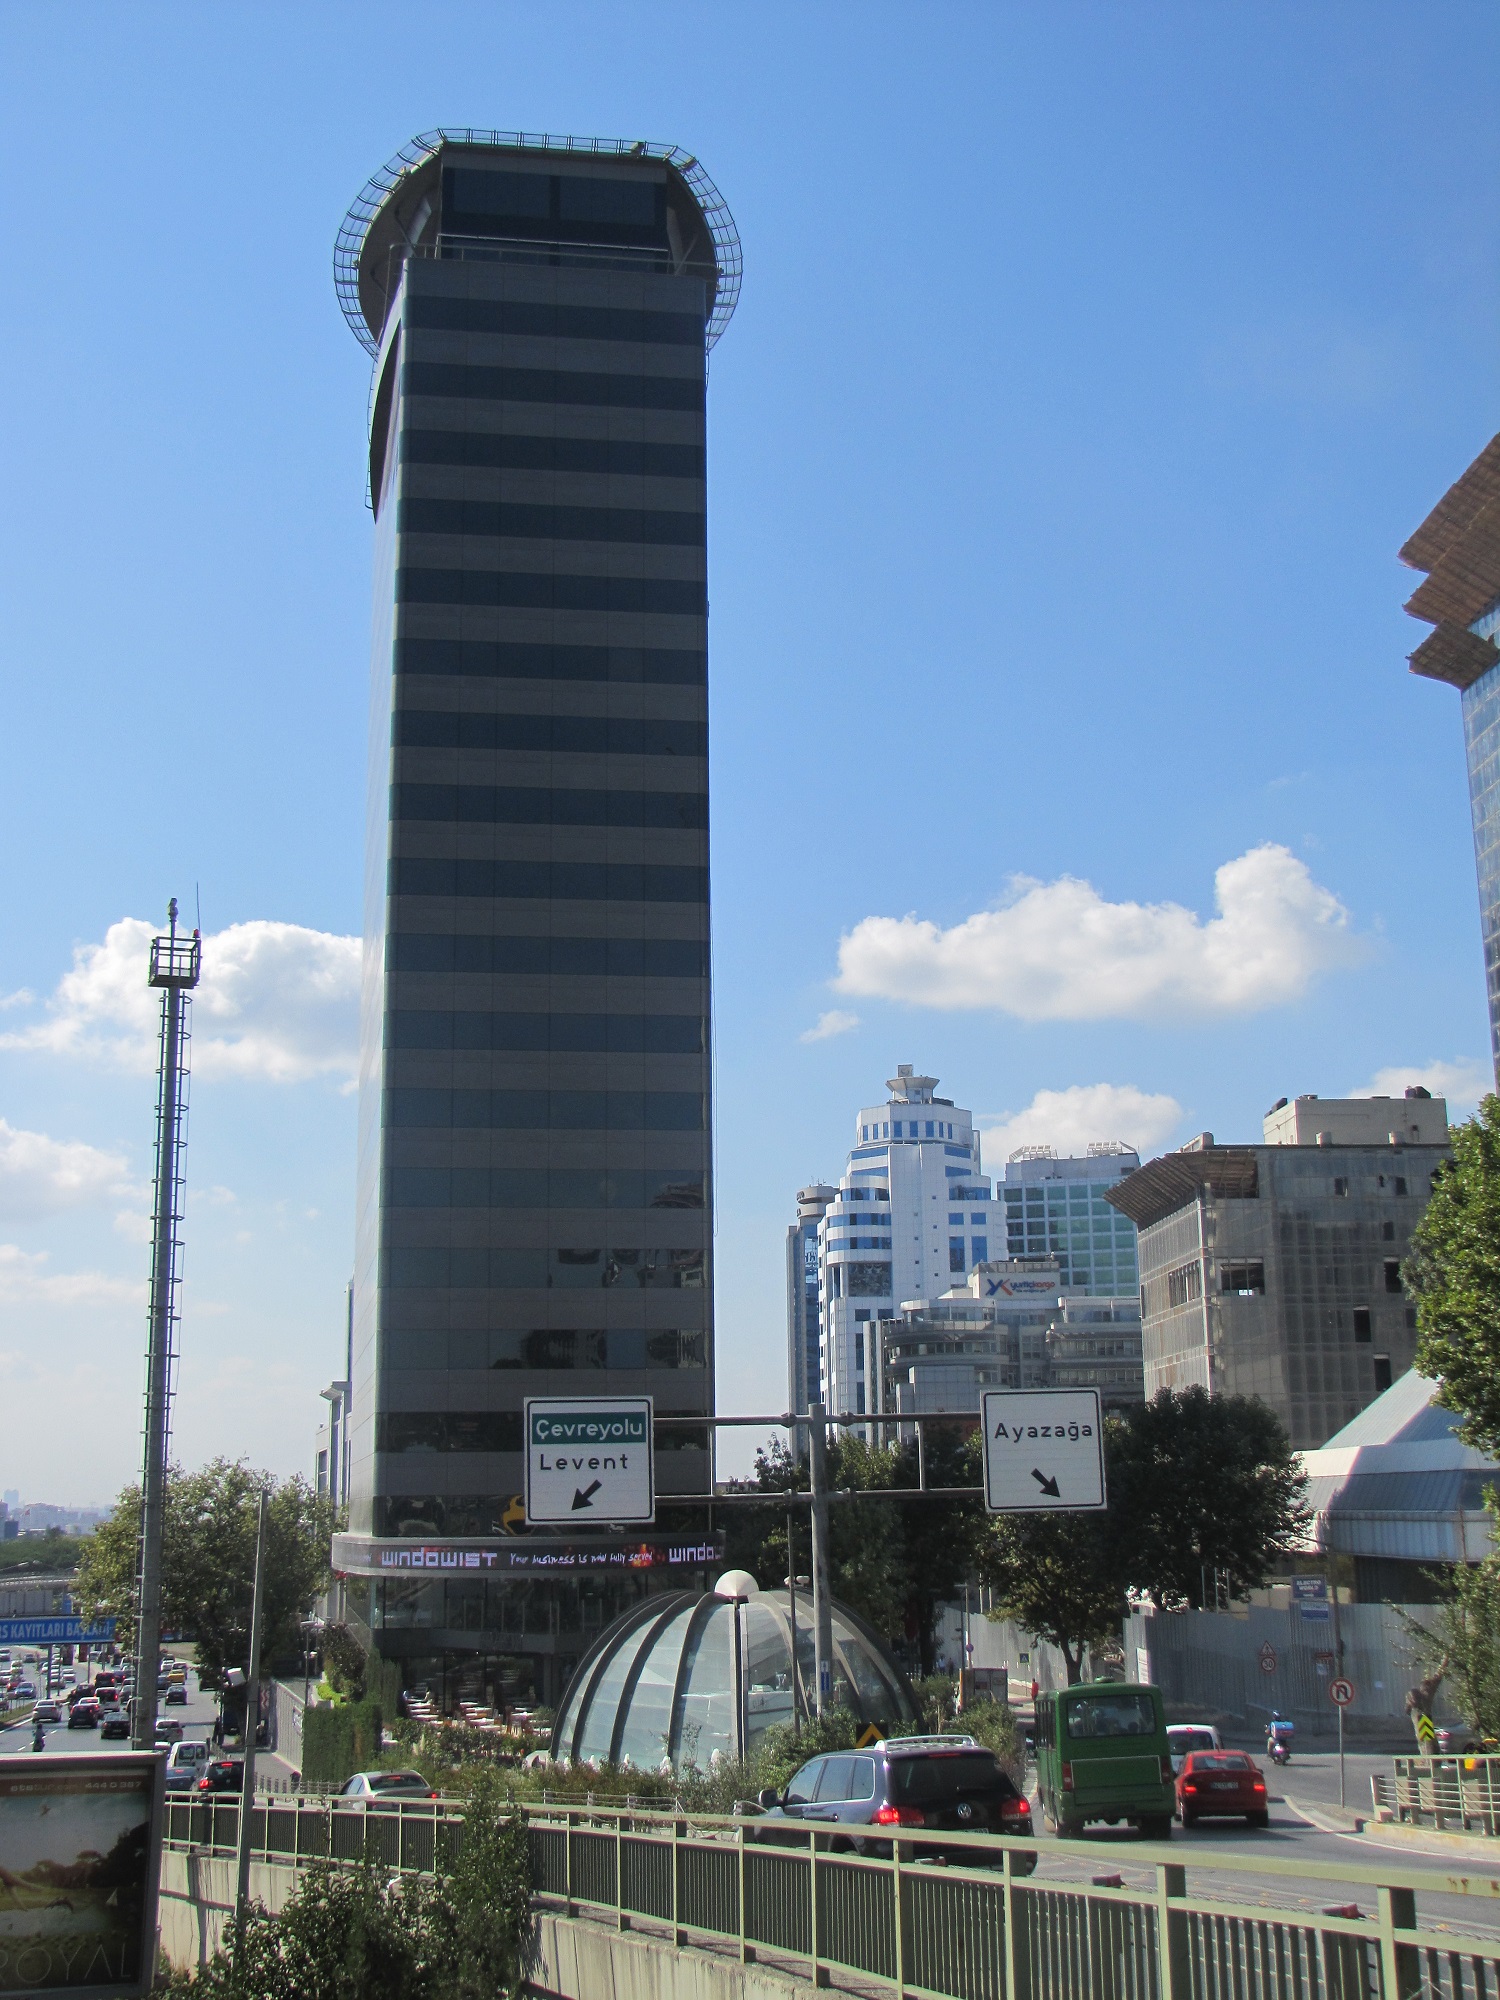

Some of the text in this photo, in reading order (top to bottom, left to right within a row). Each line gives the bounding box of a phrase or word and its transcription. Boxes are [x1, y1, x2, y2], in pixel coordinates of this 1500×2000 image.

[535, 1419, 643, 1440] Çevreyolu
[994, 1421, 1093, 1443] Ayazağa
[540, 1453, 629, 1471] Levent
[532, 1554, 575, 1565] business
[578, 1553, 588, 1564] is
[10, 1622, 64, 1638] KAYITLARI
